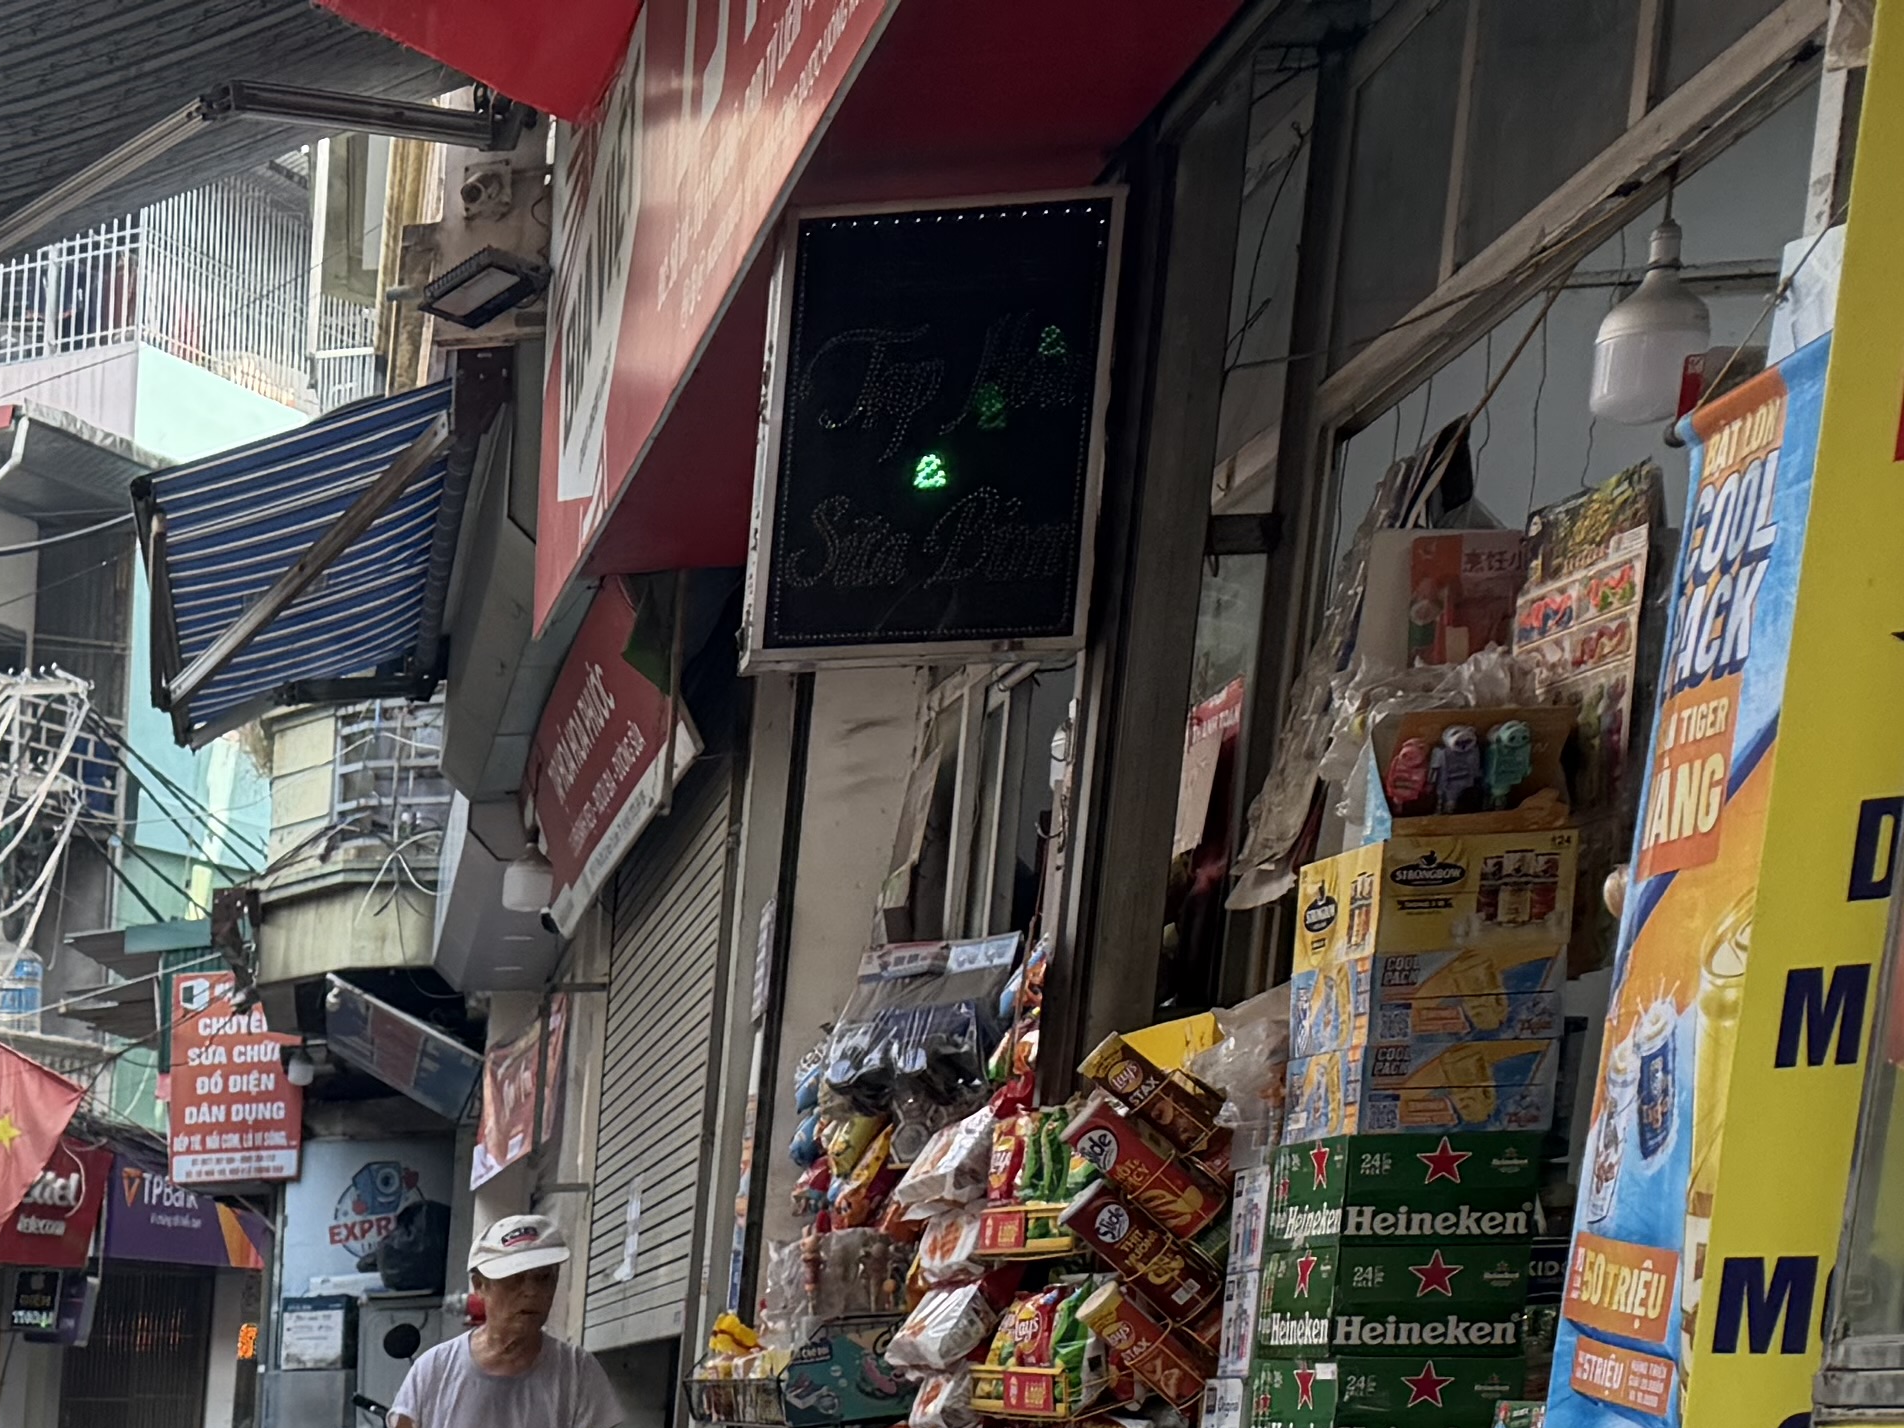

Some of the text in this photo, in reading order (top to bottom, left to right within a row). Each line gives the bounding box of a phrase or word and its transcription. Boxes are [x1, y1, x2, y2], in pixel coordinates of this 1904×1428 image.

[1683, 450, 1779, 583] COOL
[1679, 696, 1729, 744] TIGER
[228, 1072, 275, 1096] ĐIỆN
[1128, 1076, 1160, 1105] STAX
[184, 1101, 286, 1125] DÂN DỤNG
[1080, 1132, 1112, 1161] ide
[1361, 1153, 1380, 1168] 24
[328, 1216, 393, 1246] EXPR
[1284, 1203, 1342, 1240] Heineken
[1343, 1202, 1529, 1237] Heineken
[1353, 1266, 1374, 1281] 24
[1270, 1310, 1329, 1346] Heineken
[1332, 1315, 1517, 1347] Heineken
